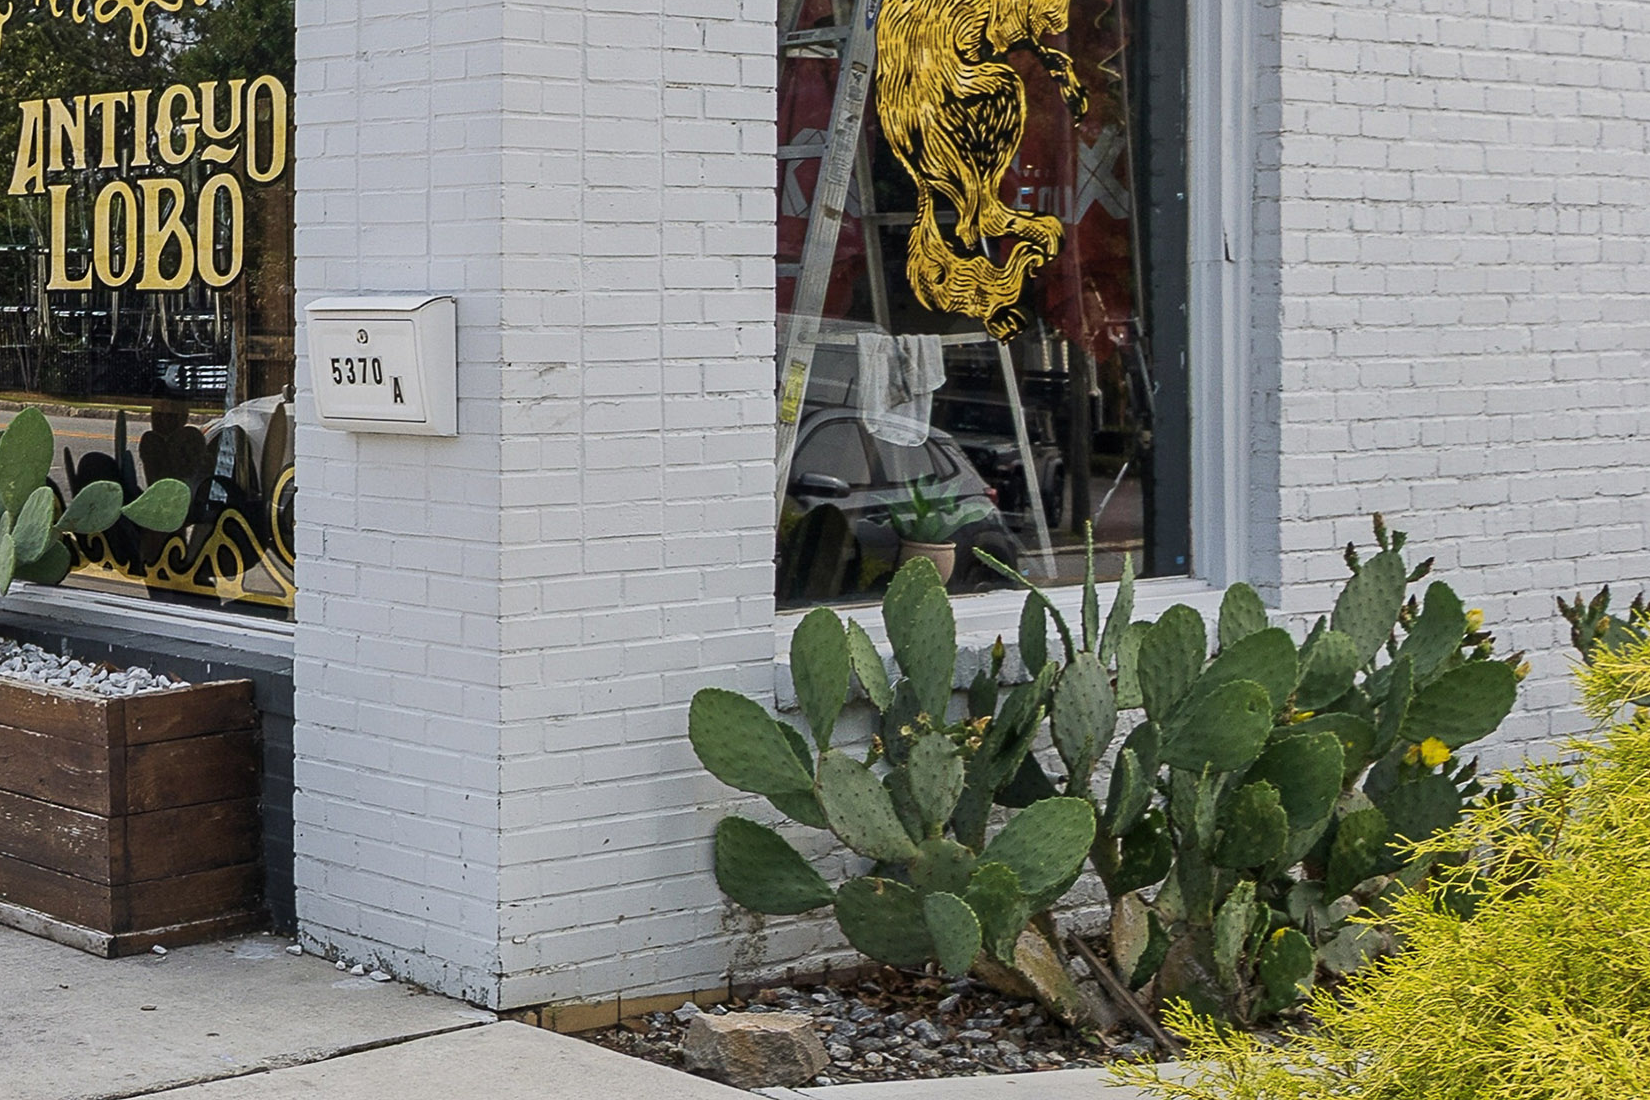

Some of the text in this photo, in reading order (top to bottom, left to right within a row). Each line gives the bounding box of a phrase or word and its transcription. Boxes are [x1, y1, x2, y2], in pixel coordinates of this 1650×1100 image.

[7, 74, 287, 196] ANTIGUO
[47, 172, 244, 291] LOBO
[330, 357, 404, 404] 5370 A
